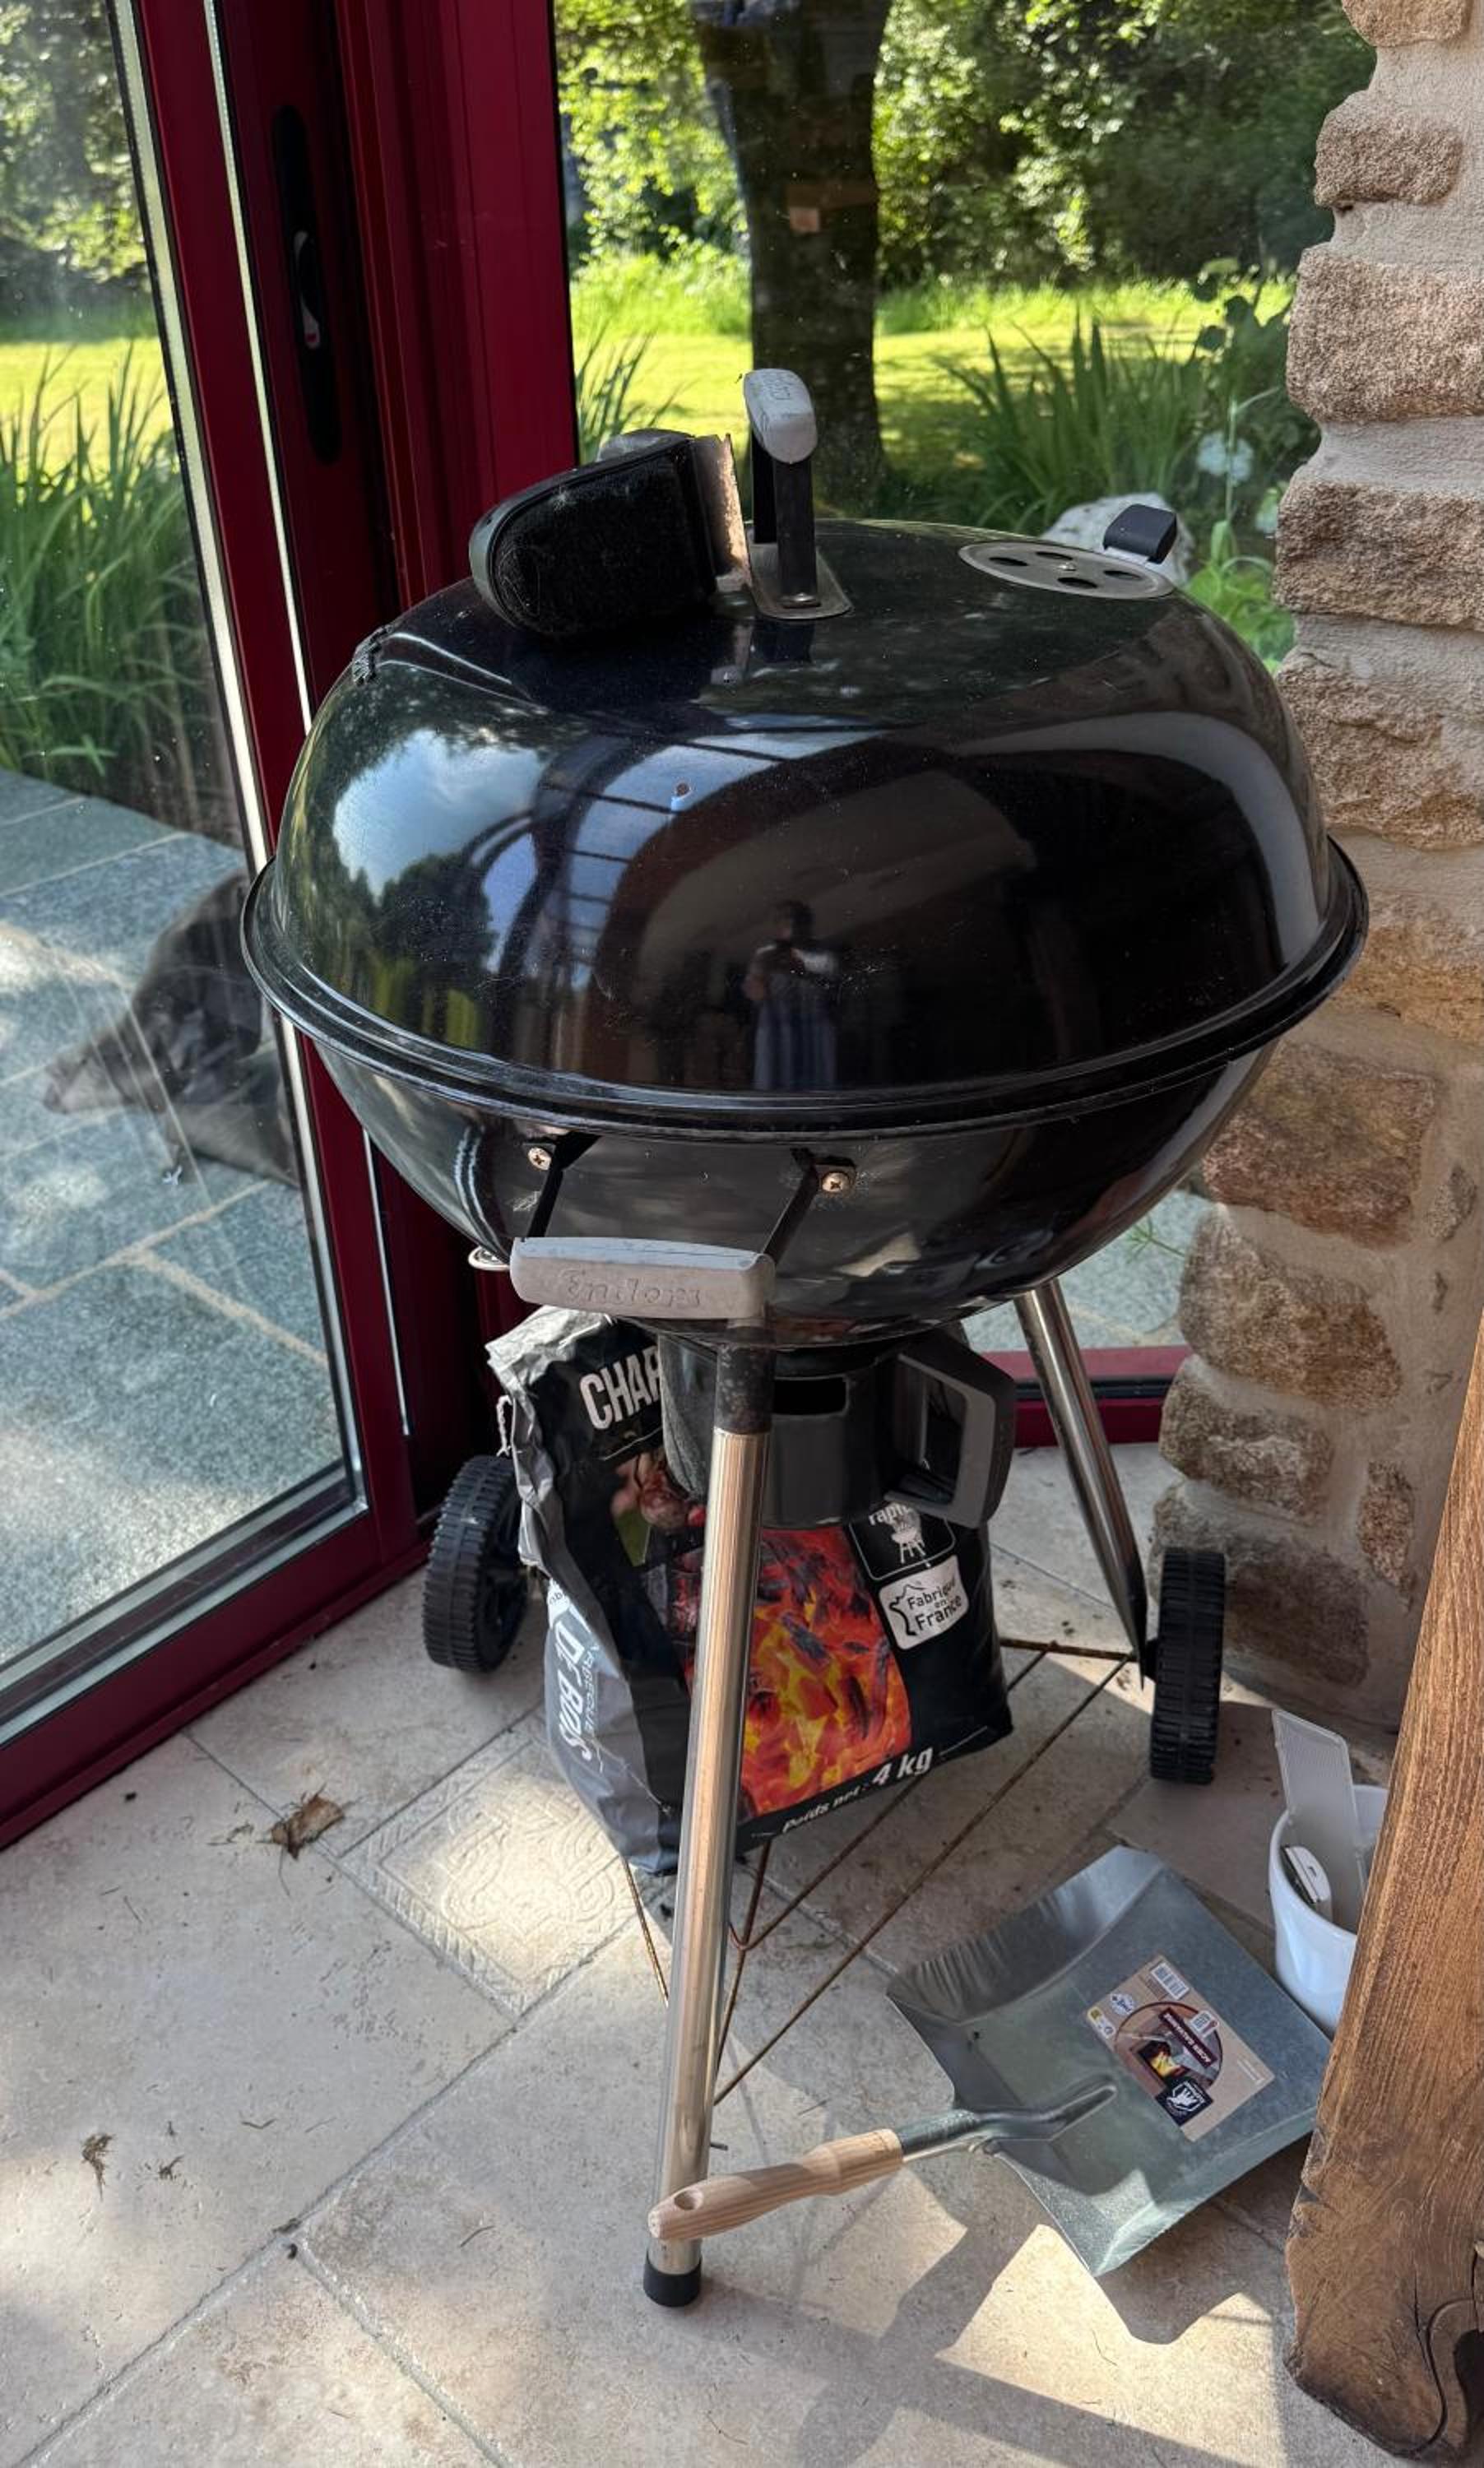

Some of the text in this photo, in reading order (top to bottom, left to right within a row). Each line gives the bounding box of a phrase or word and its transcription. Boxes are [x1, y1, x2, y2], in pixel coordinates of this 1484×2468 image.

[915, 1595, 962, 1631] France
[934, 1598, 947, 1608] en
[871, 1763, 892, 1785] 4
[897, 1747, 933, 1779] kg
